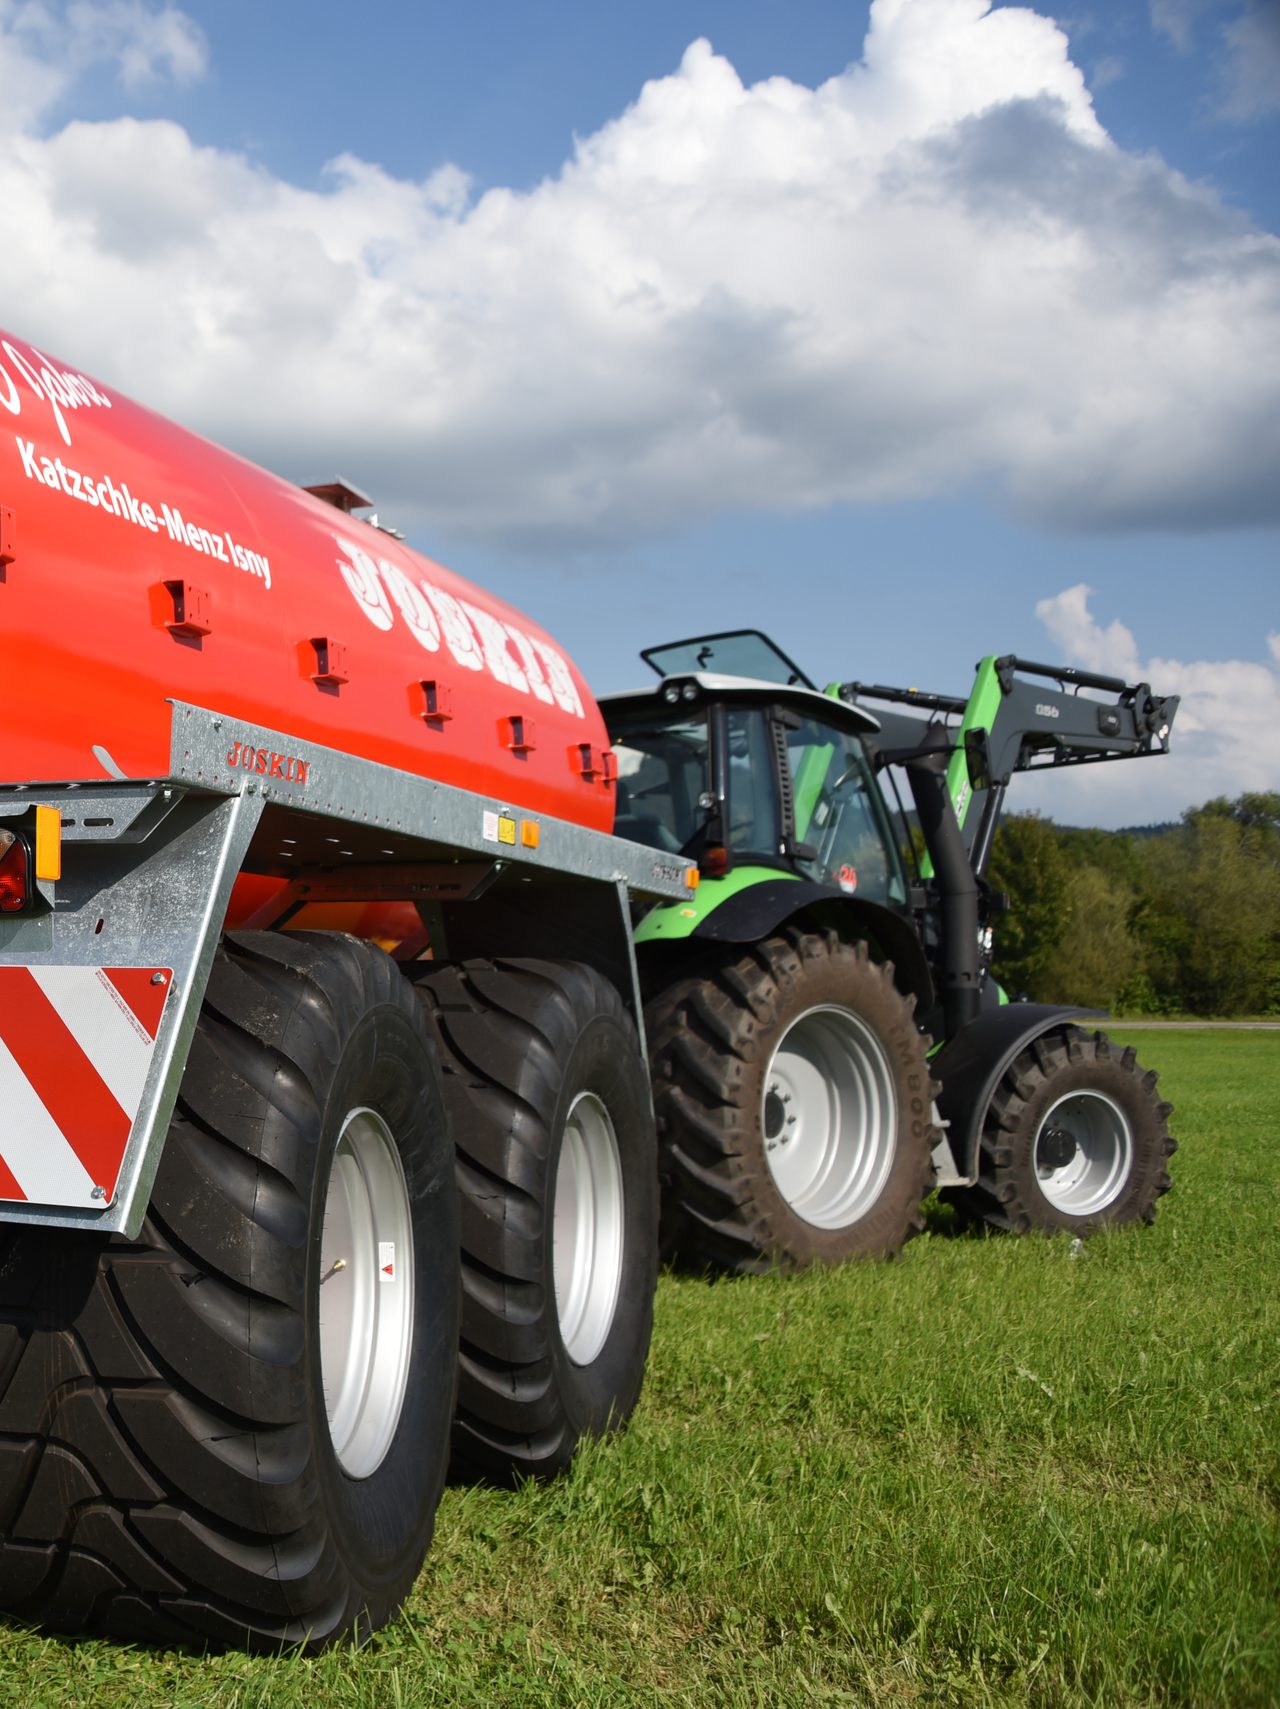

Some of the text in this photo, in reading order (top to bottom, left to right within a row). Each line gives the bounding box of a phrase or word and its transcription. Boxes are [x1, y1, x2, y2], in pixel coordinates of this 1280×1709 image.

[1, 340, 112, 446] Jahre
[15, 436, 272, 590] Katzschke-Menz Isny
[331, 533, 586, 719] JOSKIN
[227, 741, 310, 785] JOSKIN
